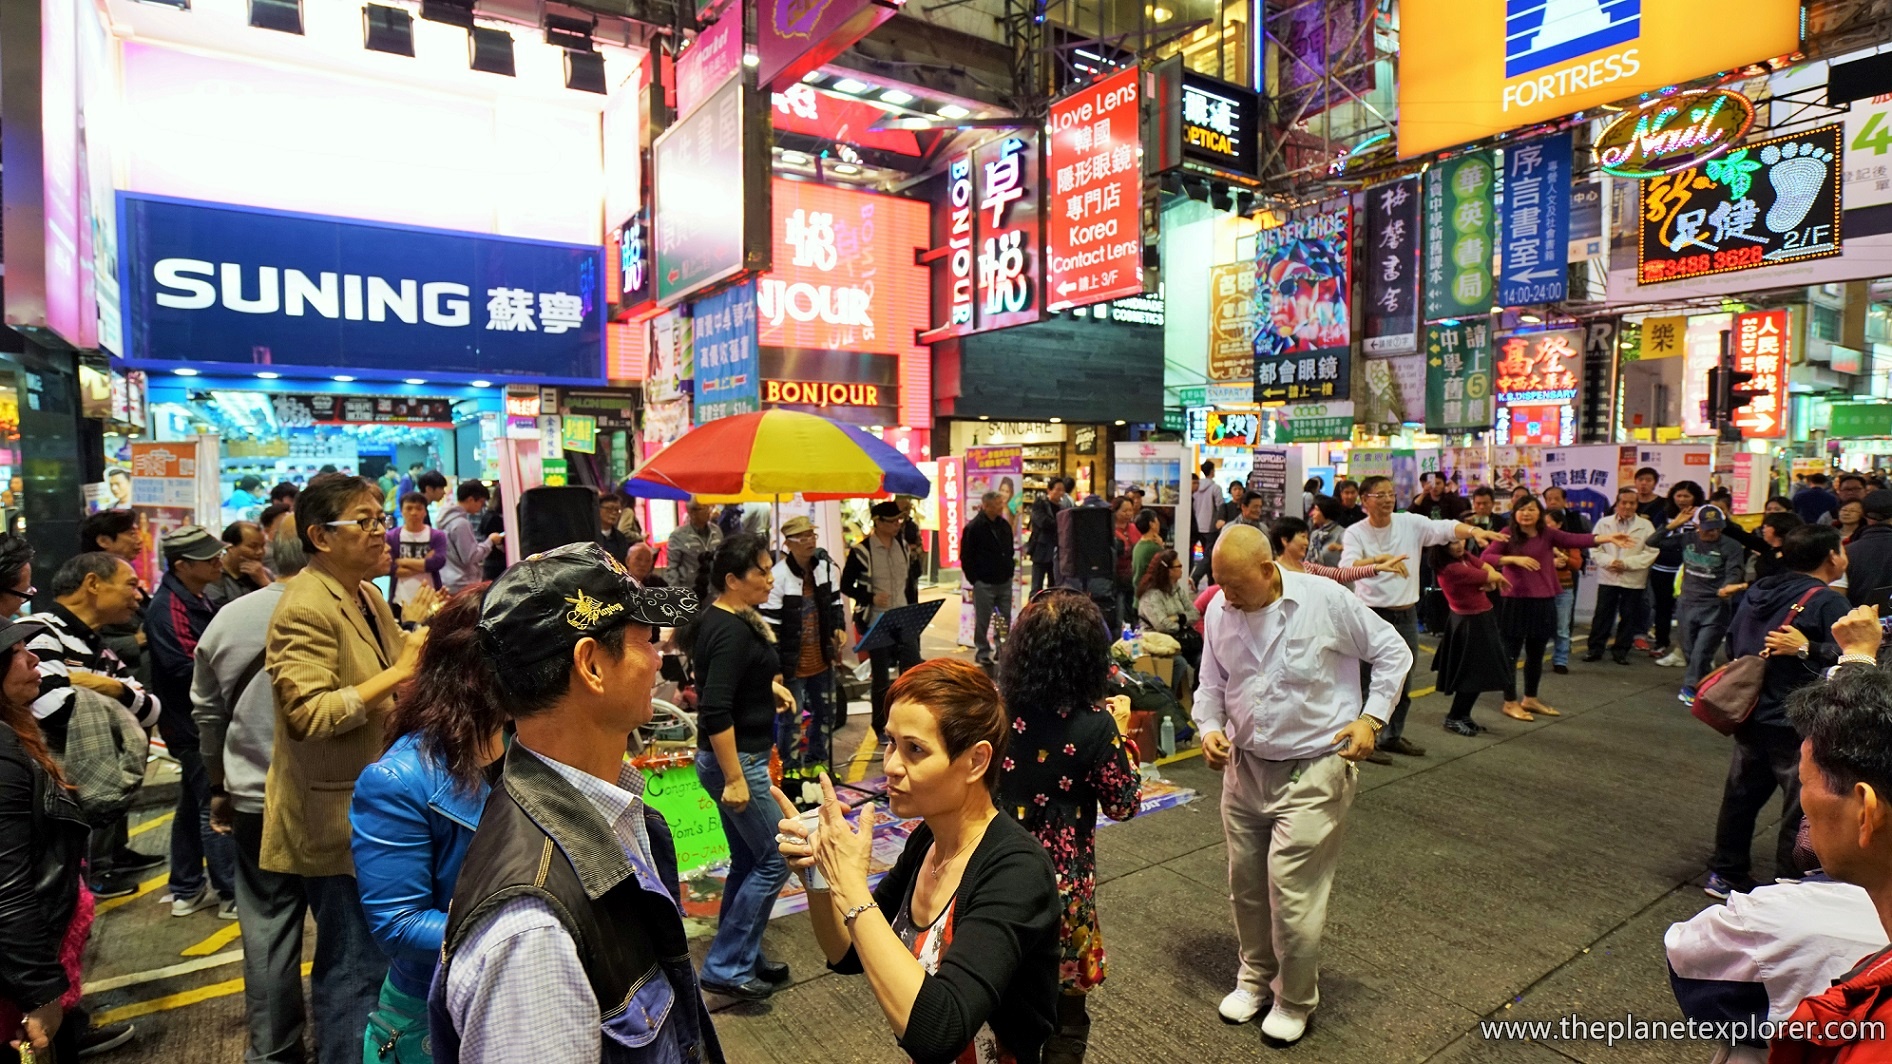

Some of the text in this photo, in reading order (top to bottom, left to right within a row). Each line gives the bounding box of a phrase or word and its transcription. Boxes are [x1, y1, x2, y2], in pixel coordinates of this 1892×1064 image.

[1502, 48, 1640, 112] FORTRESS
[1052, 82, 1137, 134] Love Lens
[1073, 117, 1111, 155] 韓國
[1183, 124, 1233, 155] OPTICAL
[1601, 95, 1727, 168] Nail
[1056, 143, 1132, 195] 隱形眼鏡
[1065, 181, 1122, 222] 專門店
[1508, 144, 1544, 269] 序言書室
[950, 159, 971, 326] BONJOUR
[1068, 217, 1118, 248] Korea
[1257, 210, 1348, 251] NEVER HIDE
[1457, 163, 1485, 299] 華英書局
[1783, 224, 1831, 250] 2/F
[1052, 239, 1138, 274] Contact Lens
[1714, 245, 1763, 271] 3628
[154, 257, 584, 334] SUNING 蘇寧
[1101, 271, 1120, 289] 3/F
[1504, 282, 1562, 304] 14:00-24:00
[1112, 308, 1165, 326] COSMETICS
[1651, 324, 1676, 352] 樂
[1741, 317, 1758, 354] MONEY
[1259, 358, 1339, 386] 都會眼鏡
[1497, 336, 1578, 376] 高登
[766, 380, 879, 408] BONJOUR
[1288, 382, 1334, 399] 請上一樓
[988, 422, 1053, 436] SKINCARE
[1550, 468, 1610, 488] 震撼價
[945, 501, 959, 562] BONJOUR
[697, 796, 714, 811] to
